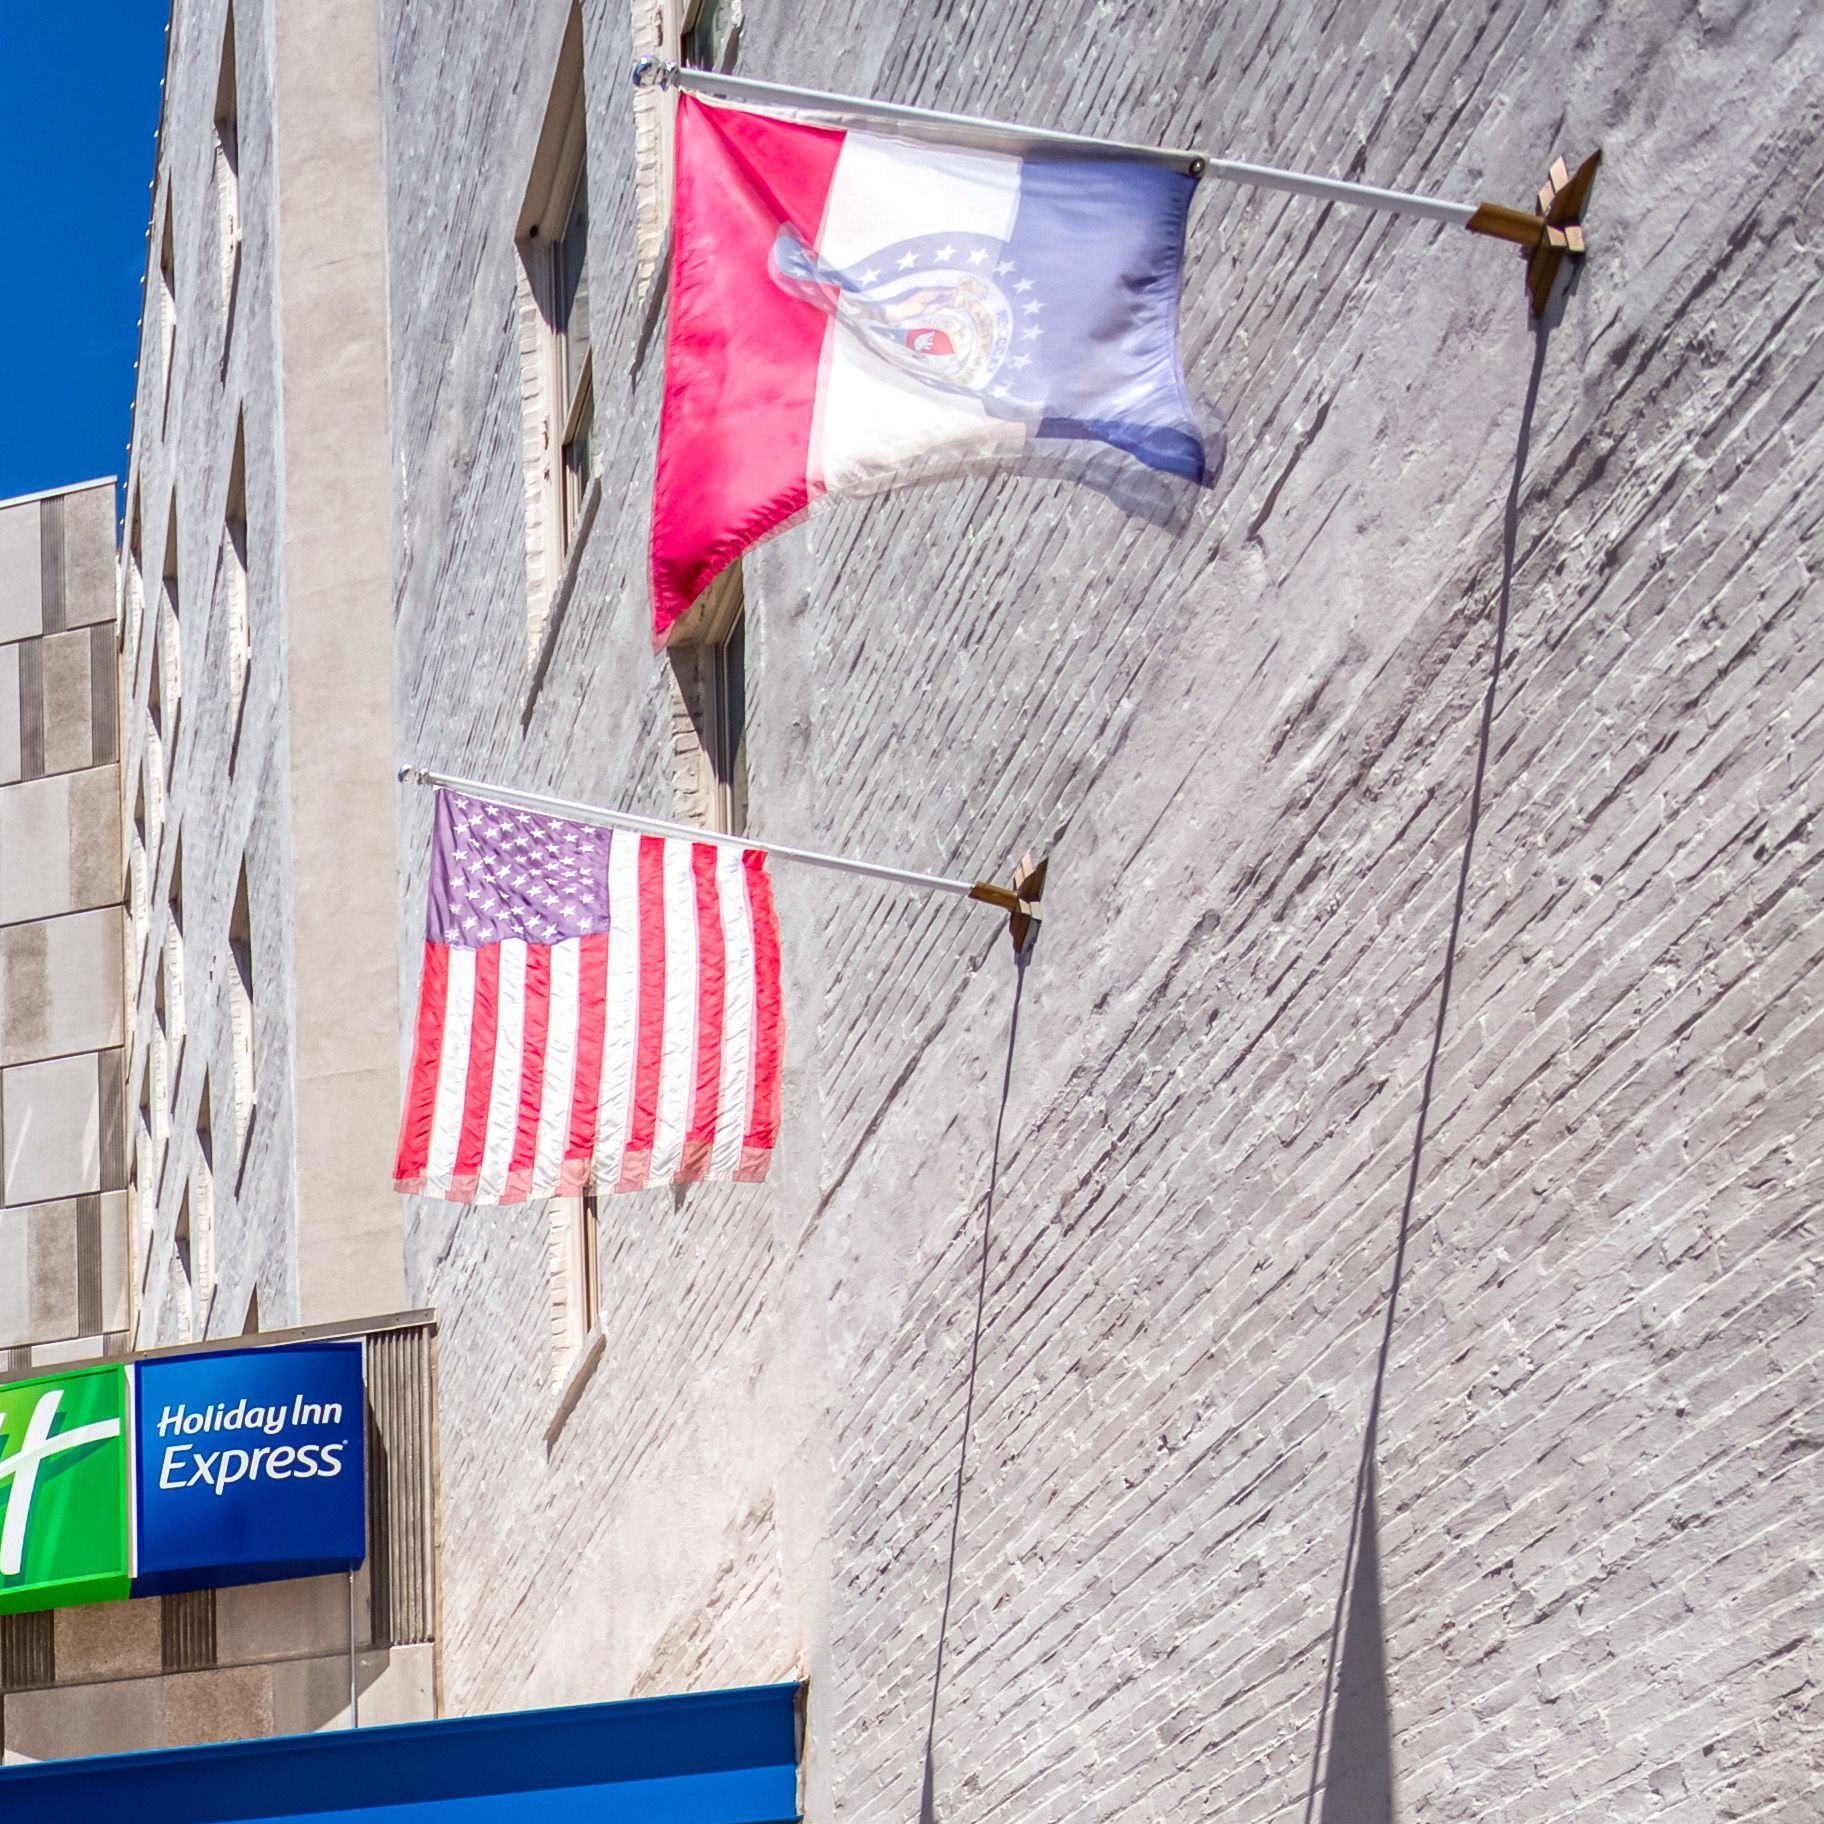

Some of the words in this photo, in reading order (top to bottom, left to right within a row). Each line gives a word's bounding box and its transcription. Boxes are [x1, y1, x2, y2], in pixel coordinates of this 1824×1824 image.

[157, 1398, 287, 1437] Holiday
[291, 1394, 342, 1426] Inn
[159, 1443, 343, 1495] Express
